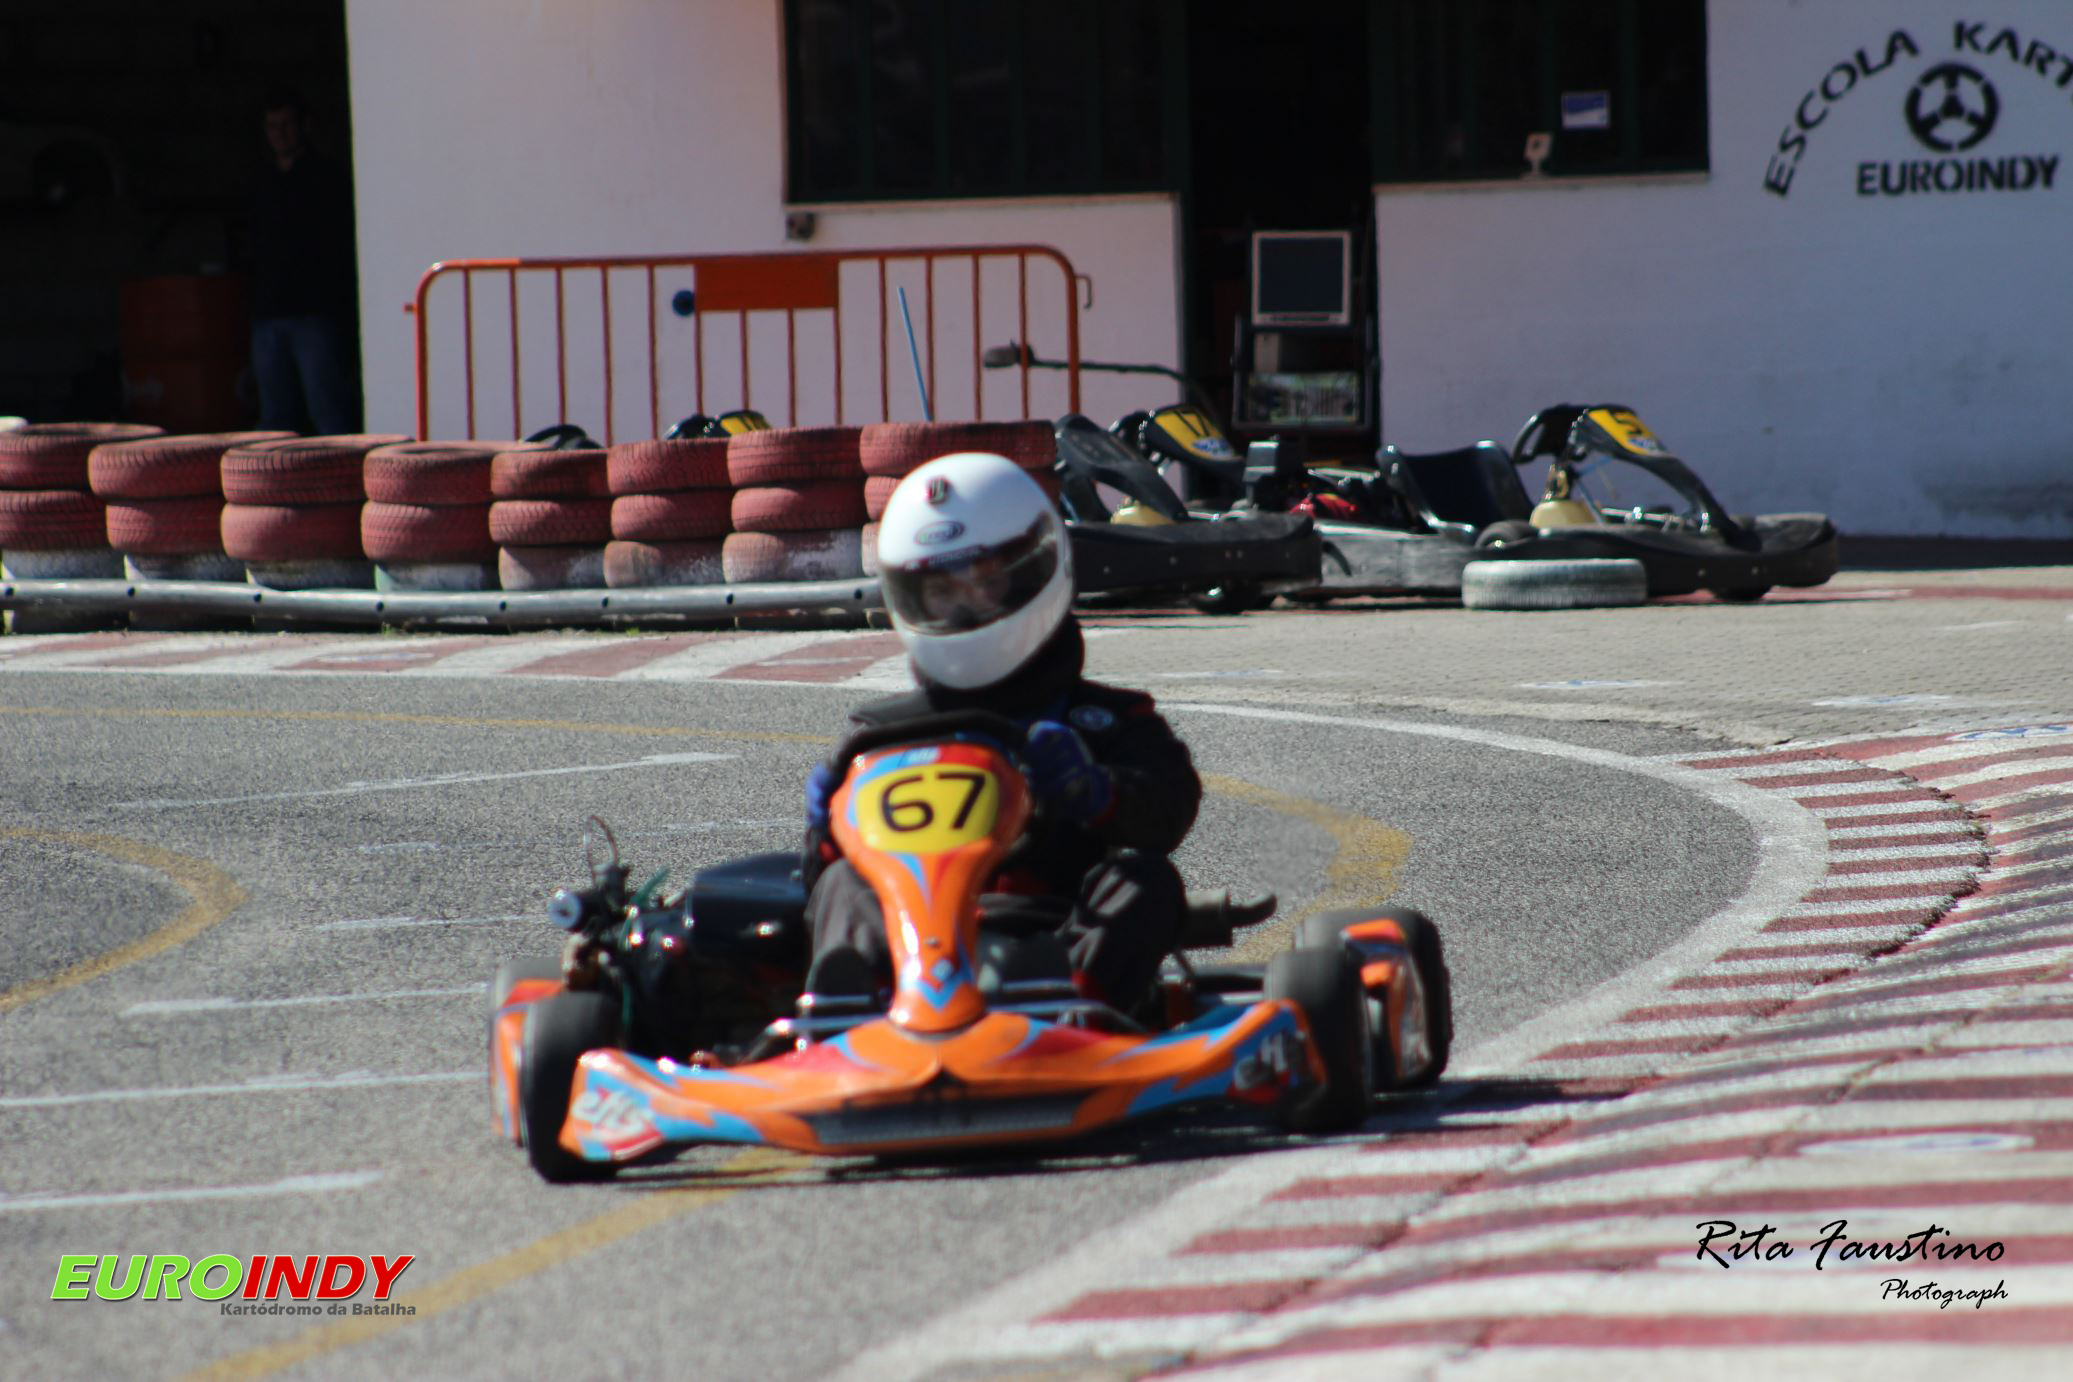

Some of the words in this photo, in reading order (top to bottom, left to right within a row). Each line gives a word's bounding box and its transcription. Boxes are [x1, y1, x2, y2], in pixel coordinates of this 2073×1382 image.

[1763, 28, 1920, 196] ESCOLA
[1856, 155, 2060, 196] EUROINDY
[880, 772, 987, 832] 67
